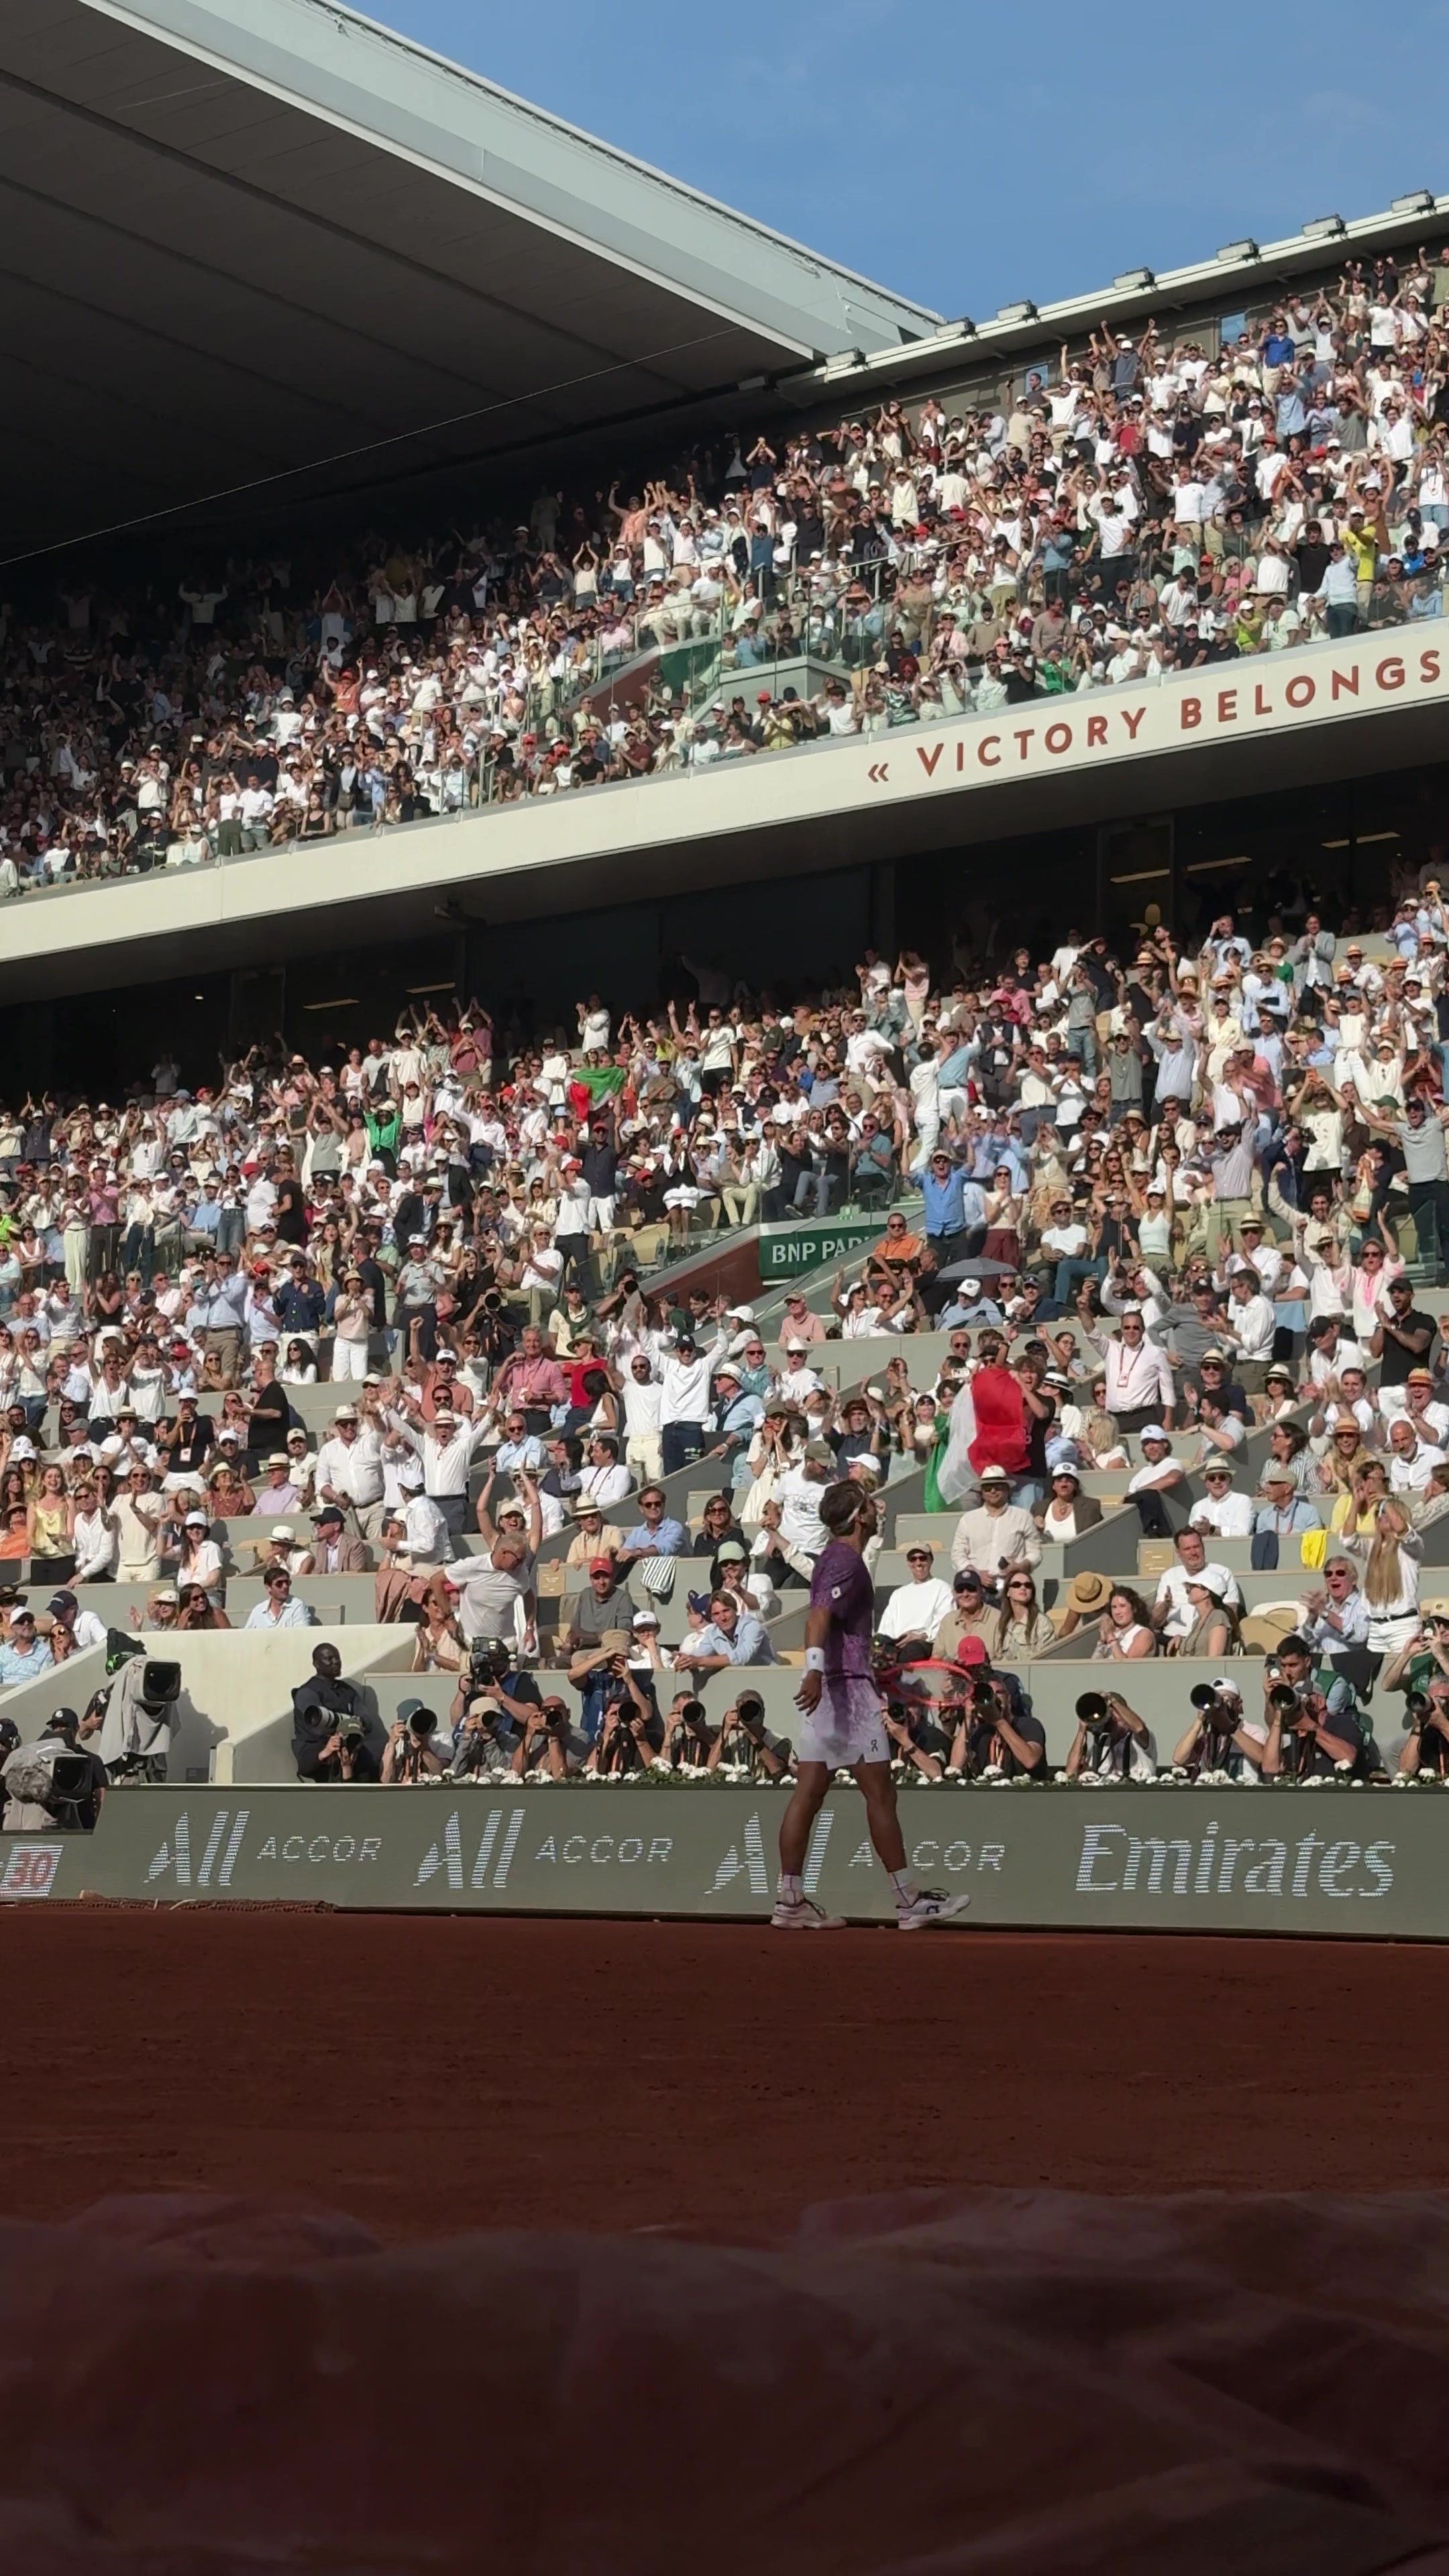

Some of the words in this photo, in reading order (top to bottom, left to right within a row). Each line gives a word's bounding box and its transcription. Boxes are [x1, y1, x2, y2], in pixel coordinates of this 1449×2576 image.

[916, 707, 1146, 777] VICTORY
[1181, 649, 1441, 730] BELONGS
[772, 1242, 816, 1264] BNP
[256, 1835, 382, 1862] ACCOR
[535, 1835, 673, 1863] ACCOR
[848, 1840, 1006, 1871] ACOR
[1075, 1820, 1396, 1897] Emirates
